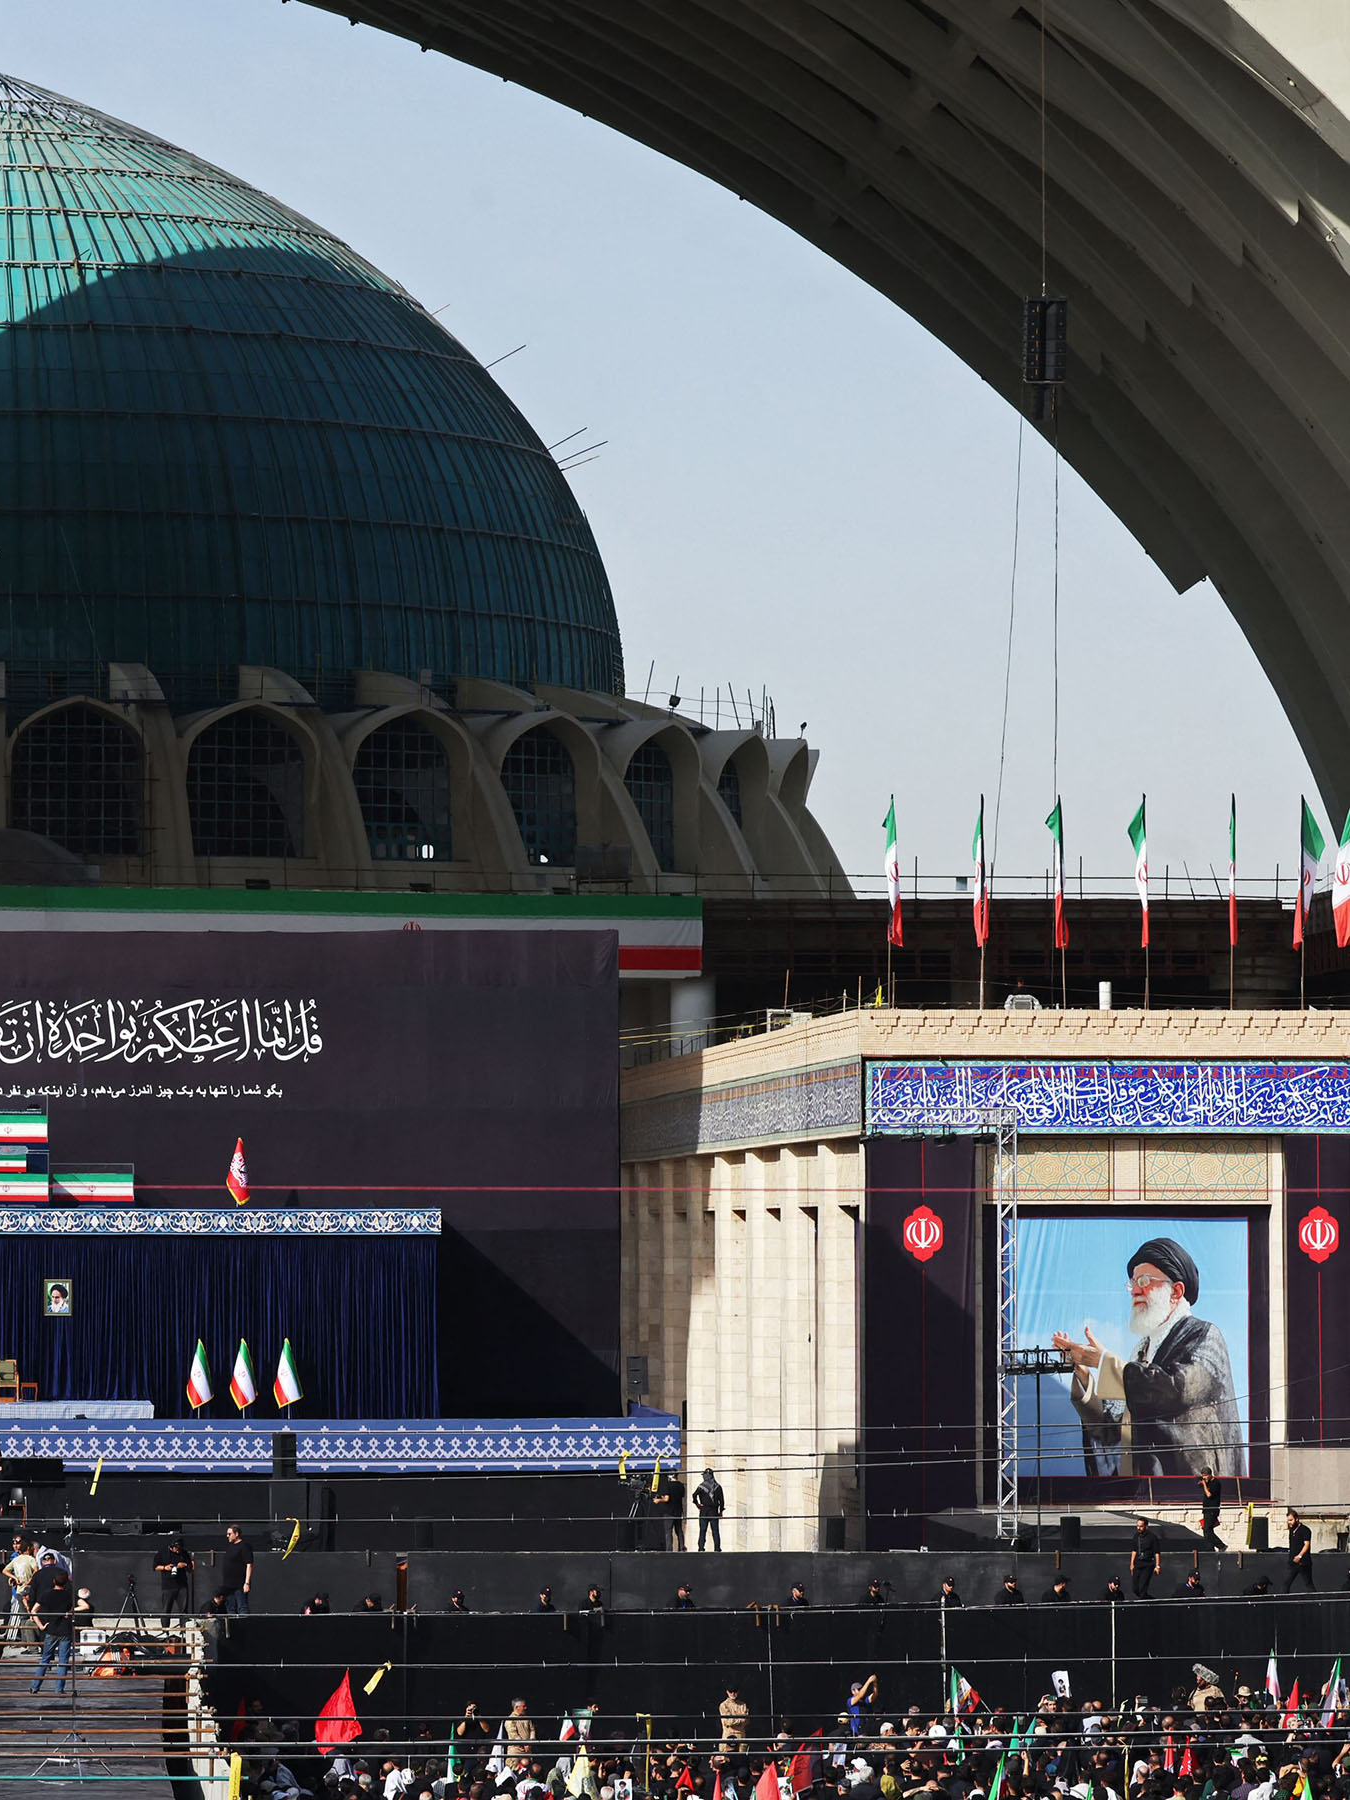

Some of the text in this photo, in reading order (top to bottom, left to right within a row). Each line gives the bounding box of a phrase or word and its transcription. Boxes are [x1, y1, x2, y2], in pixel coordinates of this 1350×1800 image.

[6, 1085, 21, 1099] نفر
[23, 1087, 35, 1099] دو
[38, 1086, 62, 1099] اینکه
[65, 1083, 76, 1098] آن
[80, 1088, 87, 1098] و
[129, 1085, 152, 1098] اندرز
[155, 1086, 173, 1099] چیز
[175, 1086, 193, 1098] یک
[195, 1086, 206, 1098] به
[209, 1085, 227, 1098] تنها
[231, 1086, 241, 1097] را
[243, 1084, 261, 1095] شما
[264, 1084, 282, 1098] بگو
